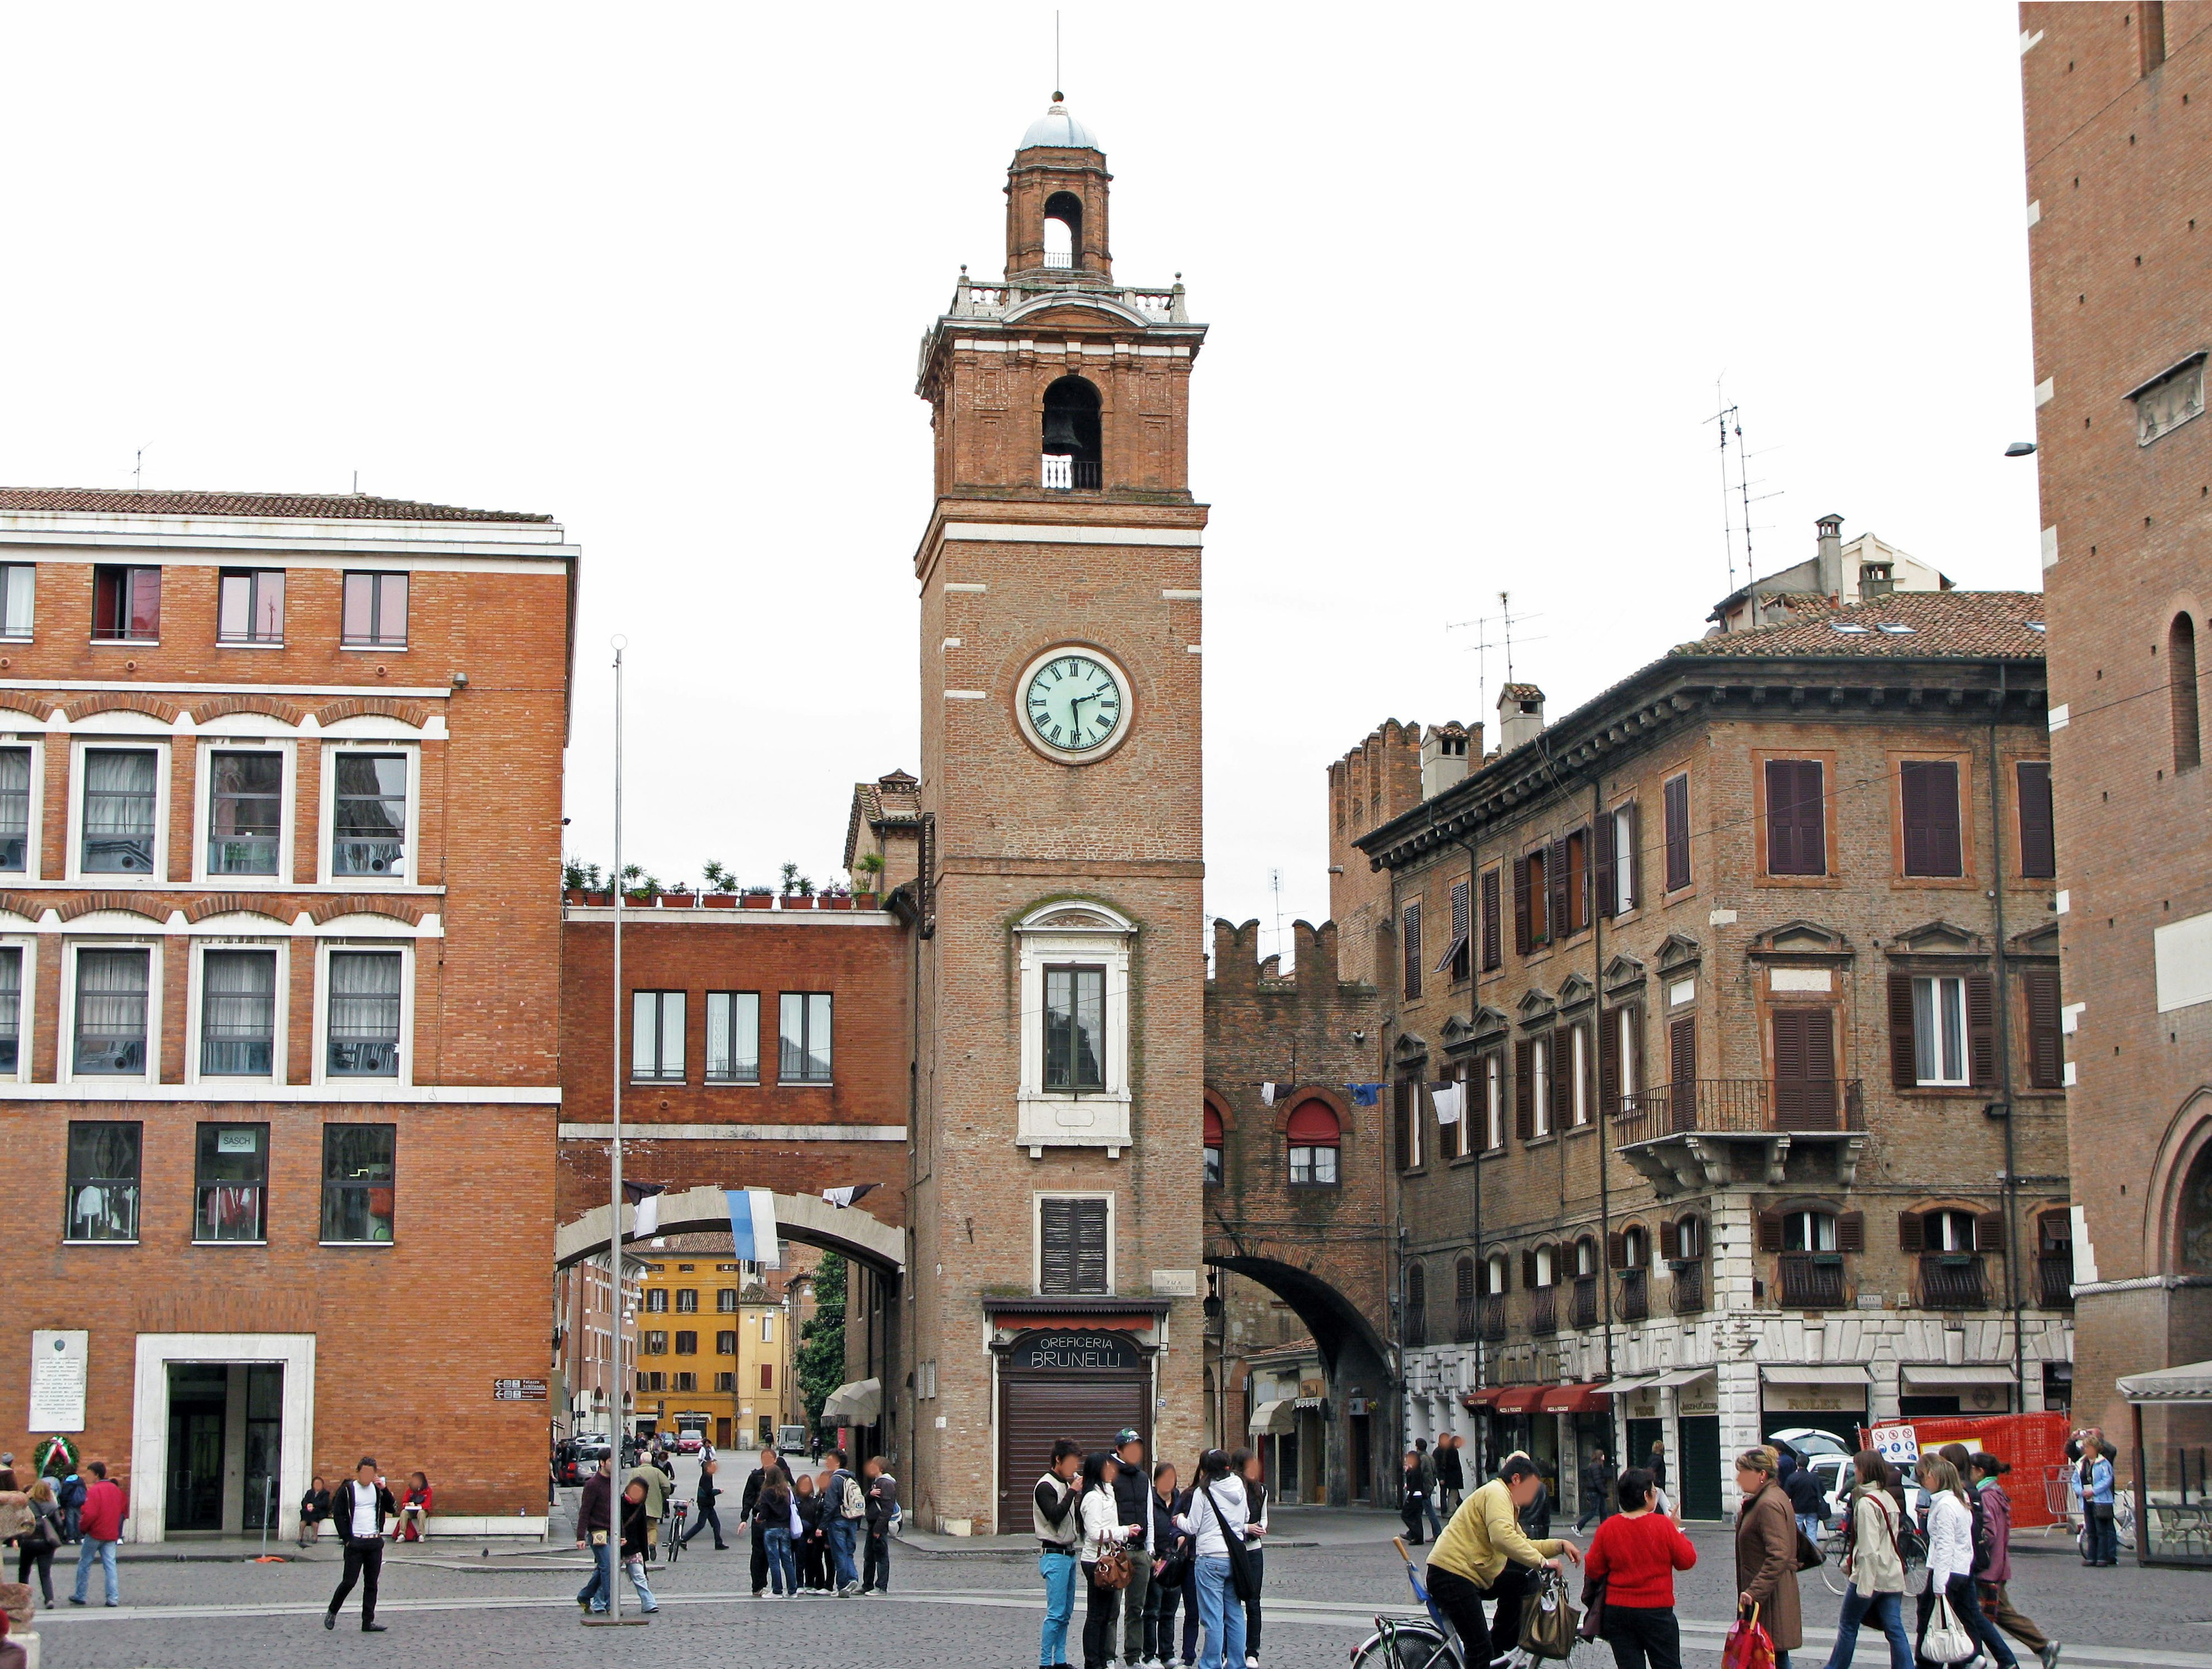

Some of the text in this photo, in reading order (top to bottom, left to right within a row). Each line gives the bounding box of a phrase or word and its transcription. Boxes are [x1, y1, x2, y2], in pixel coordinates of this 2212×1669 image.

[1050, 667, 1063, 682] XI
[1069, 663, 1078, 677] XII
[1086, 669, 1095, 681] I
[1037, 680, 1051, 692] X
[1096, 682, 1110, 692] II
[1036, 712, 1051, 727] VIII
[1050, 724, 1062, 740] VII
[1086, 727, 1096, 739] V
[224, 1137, 251, 1145] SASCH
[1040, 1337, 1113, 1350] OREFICERIA
[1031, 1351, 1120, 1369] BRUNELLI
[1787, 1398, 1842, 1410] ROLEX
